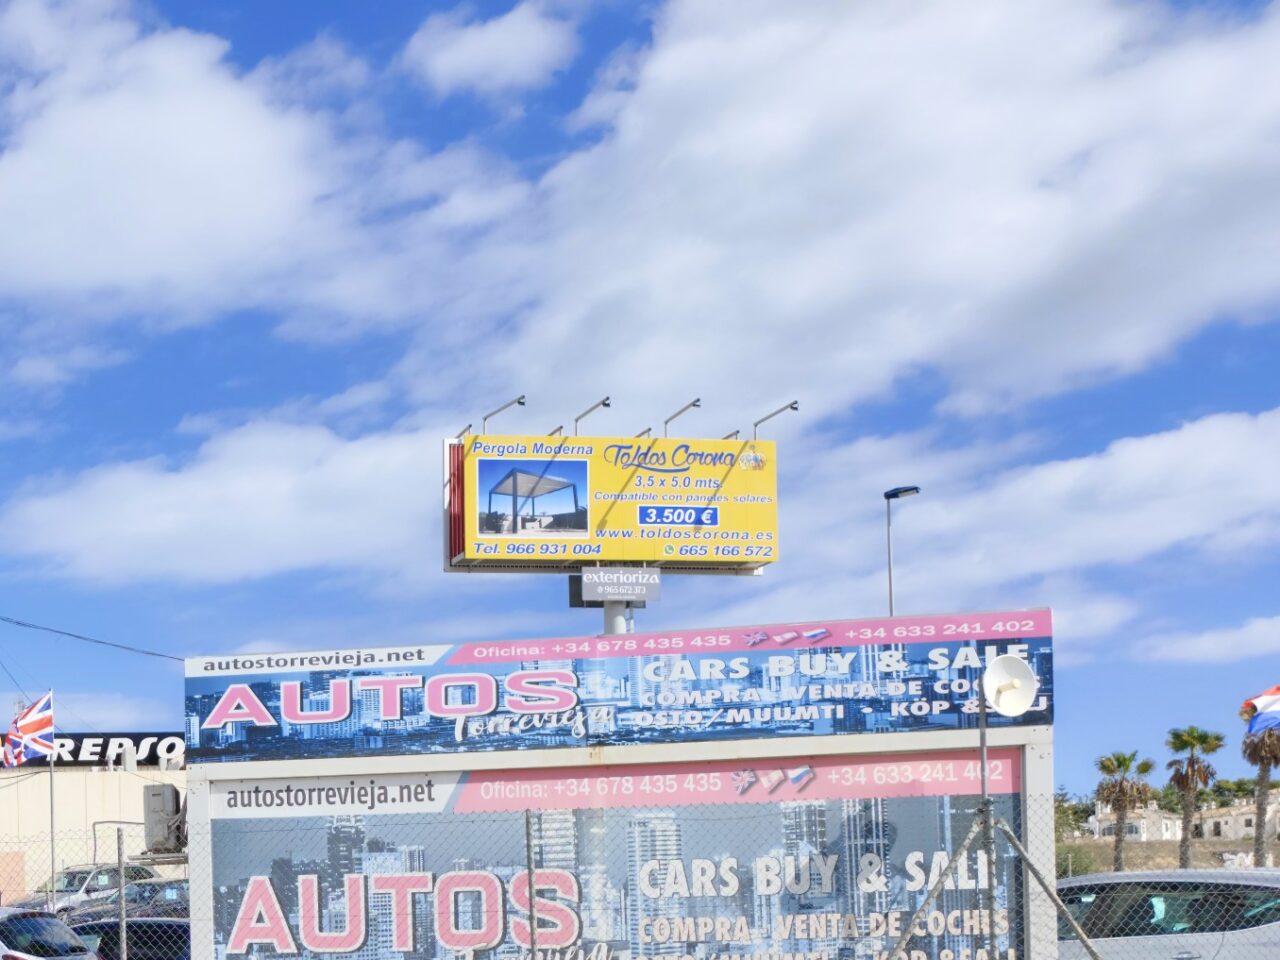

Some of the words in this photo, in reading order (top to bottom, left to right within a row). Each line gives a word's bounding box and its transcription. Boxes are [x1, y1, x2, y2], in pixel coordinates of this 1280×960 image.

[532, 442, 593, 455] Moderna
[671, 444, 735, 467] Corona
[634, 475, 655, 489] 3,5
[671, 476, 691, 489] 5,0
[694, 476, 724, 489] mts.
[594, 491, 658, 503] Compatible
[661, 494, 682, 502] con
[685, 493, 729, 503] paneles
[733, 494, 773, 503] solares
[645, 509, 696, 524] 3.500
[701, 509, 713, 524] €
[595, 528, 773, 540] www.toldoscorona.es
[473, 543, 501, 554] Tel.
[506, 543, 536, 554] 966
[539, 544, 567, 555] 931
[572, 544, 602, 555] 004
[679, 545, 708, 556] 665
[714, 545, 740, 556] 166
[744, 546, 773, 557] 572
[583, 570, 660, 584] exterioriza
[203, 647, 426, 673] autostorrevieja.net
[473, 645, 545, 659] Oficina:
[552, 641, 590, 655] +34
[596, 638, 637, 652] 678
[643, 636, 685, 650] 435
[690, 634, 731, 648] 435
[845, 627, 887, 640] +34
[892, 625, 937, 639] 633
[943, 622, 984, 636] 241
[991, 620, 1035, 634] 402
[643, 656, 750, 683] CARS
[768, 651, 857, 677] BUY
[877, 649, 909, 673] &
[201, 670, 580, 729] AUTOS
[640, 687, 763, 706] COMPRA
[783, 680, 876, 701] VENTA
[888, 679, 922, 696] DE
[891, 697, 950, 716] KÖP
[227, 778, 435, 809] autostorrevieja.net
[480, 779, 549, 799] Oficina:
[553, 777, 590, 797] +34
[596, 774, 632, 795] 678
[639, 773, 678, 793] 435
[683, 771, 721, 791] 435
[828, 766, 867, 786] +34
[873, 764, 914, 784] 633
[919, 762, 958, 782] 241
[639, 857, 740, 899] CARS
[755, 853, 839, 896] BUY
[857, 851, 889, 894] &
[226, 868, 582, 954] AUTOS
[639, 915, 749, 945] COMPRA
[776, 911, 859, 941] VENTA
[870, 910, 902, 937] DE
